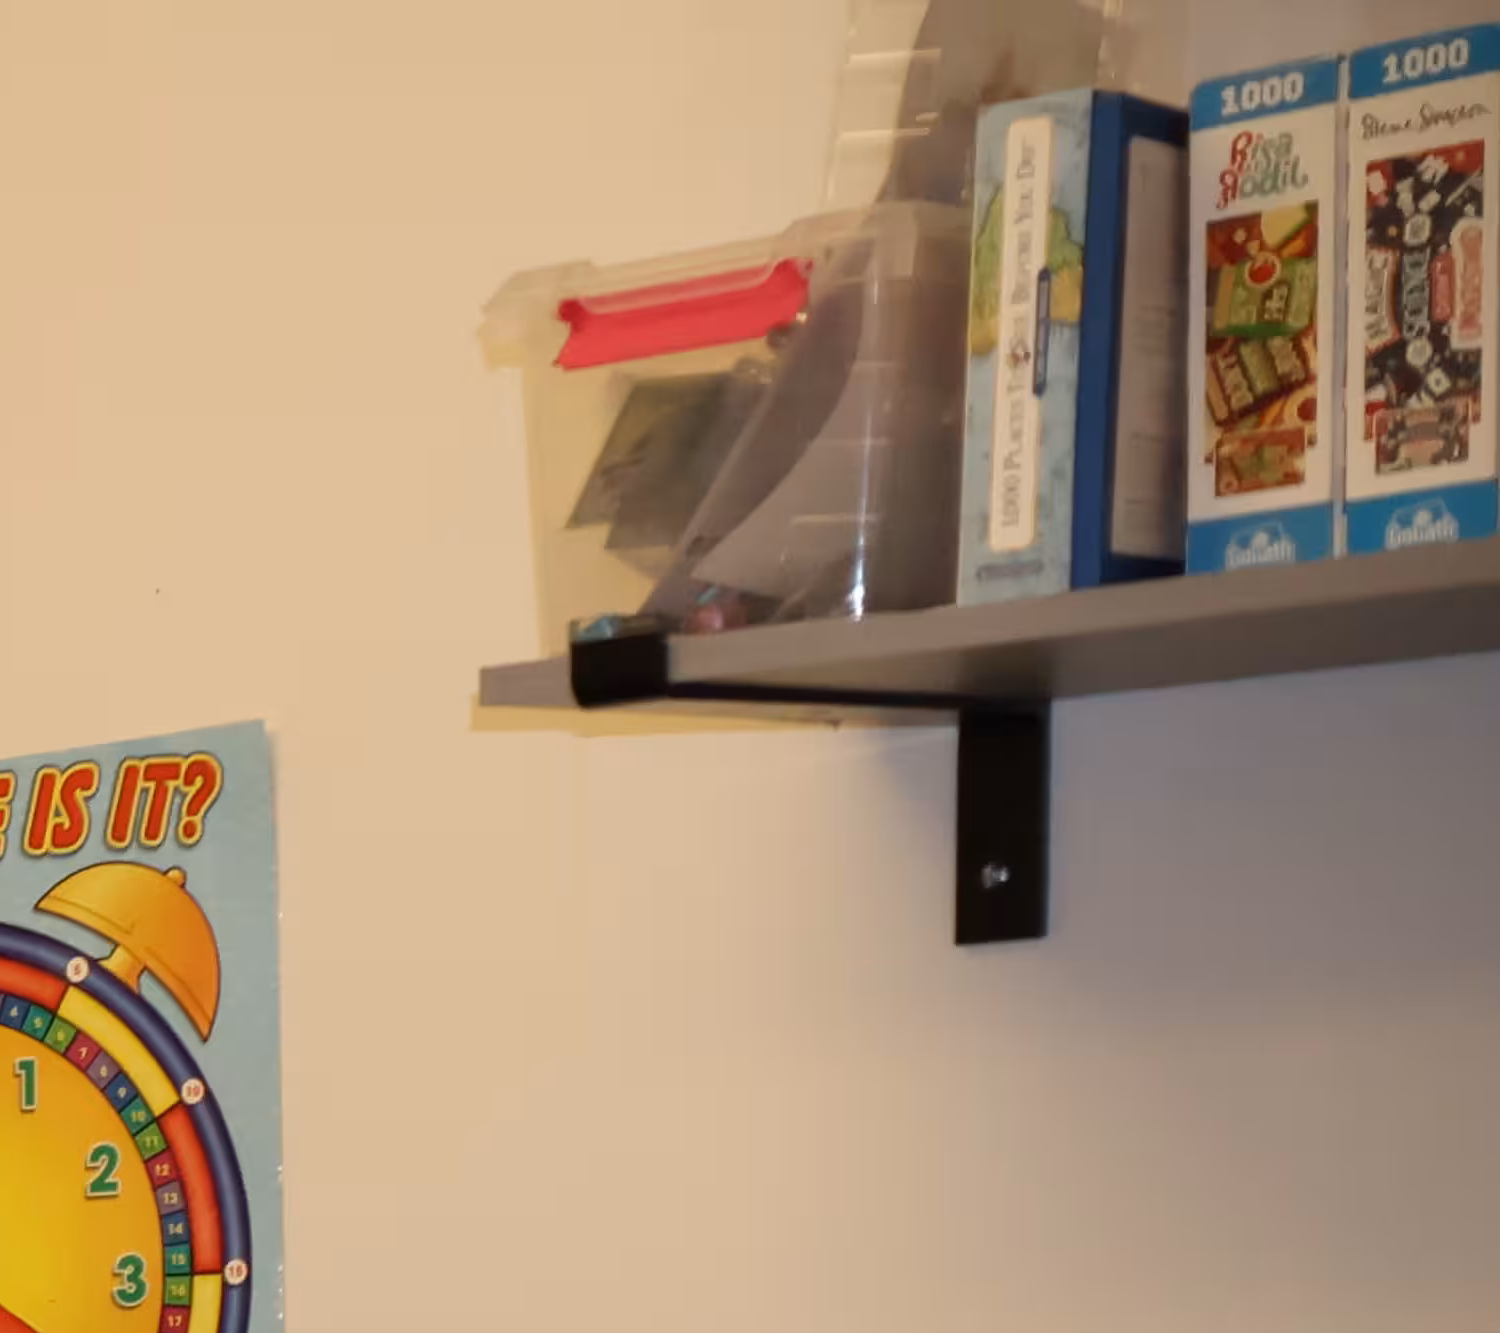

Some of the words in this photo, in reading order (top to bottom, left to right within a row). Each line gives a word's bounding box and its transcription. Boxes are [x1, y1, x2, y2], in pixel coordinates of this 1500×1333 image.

[1383, 37, 1470, 85] 1000
[1221, 71, 1305, 118] 1000
[21, 760, 100, 857] IS
[105, 751, 224, 848] IT?
[15, 1056, 38, 1112] 1
[84, 1142, 120, 1199] 2
[111, 1252, 148, 1308] 3
